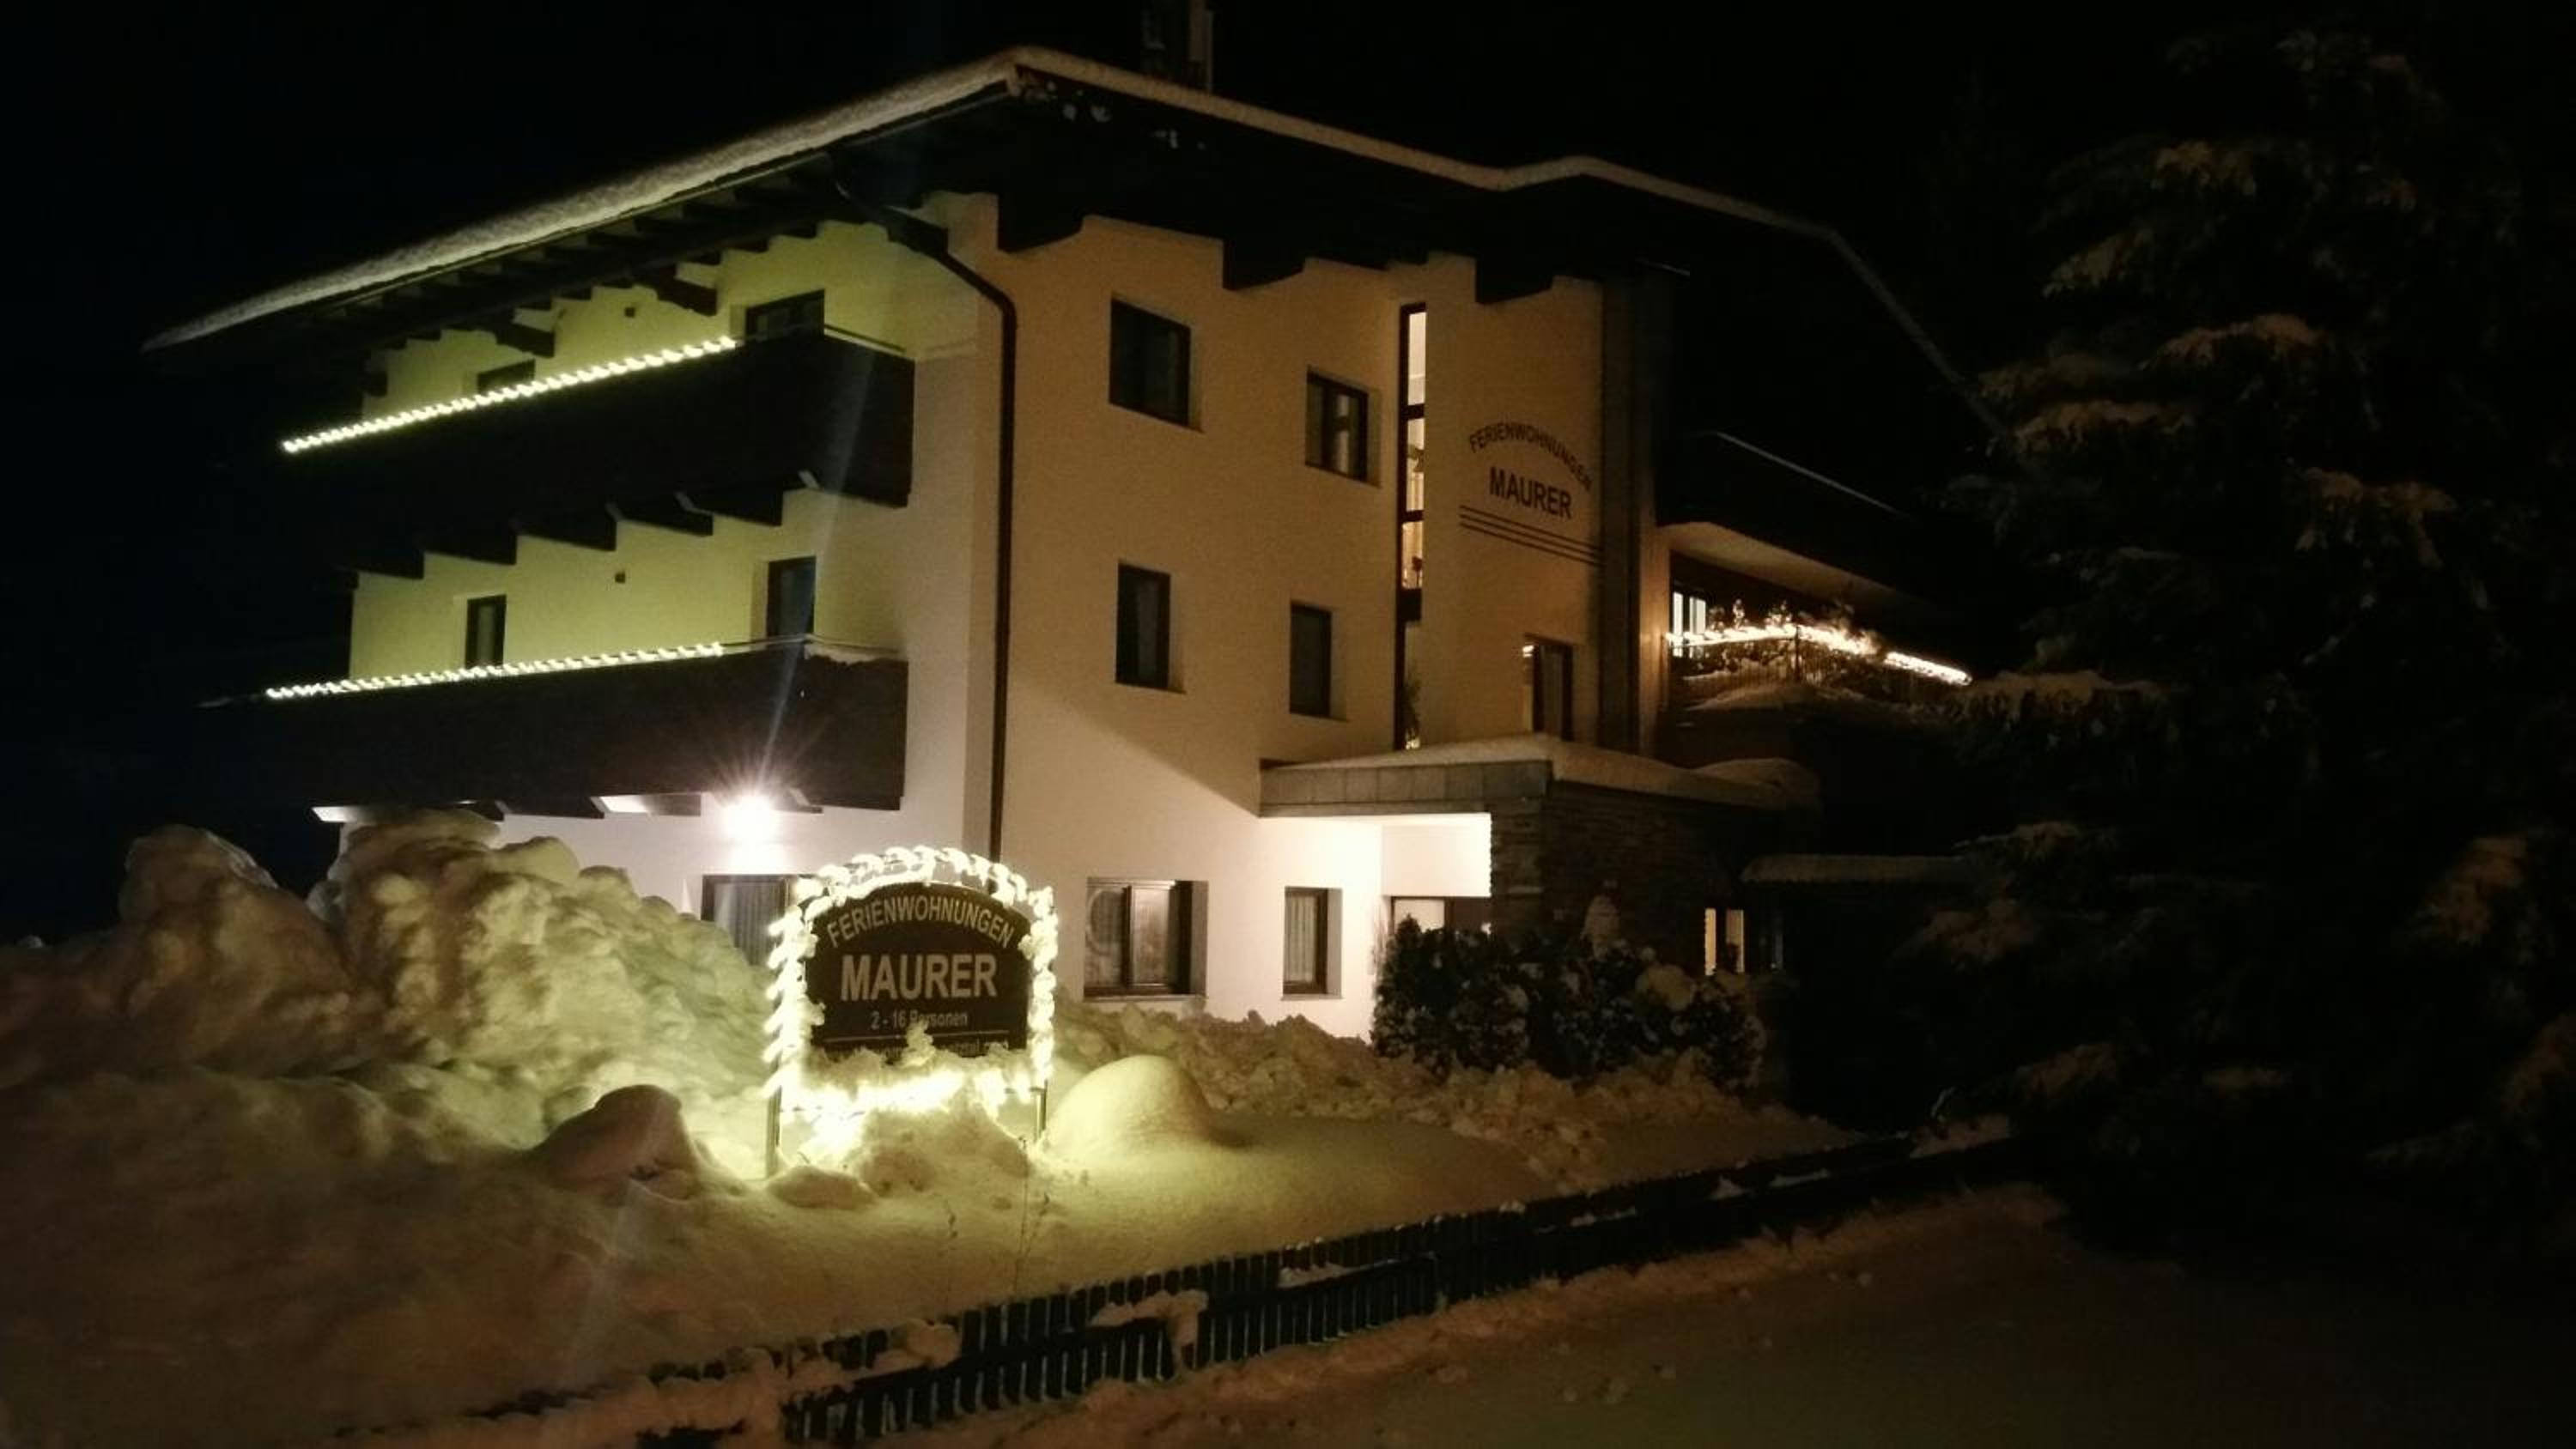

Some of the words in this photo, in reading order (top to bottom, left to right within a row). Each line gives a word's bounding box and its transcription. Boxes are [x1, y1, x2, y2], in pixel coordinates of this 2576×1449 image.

[1469, 421, 1593, 492] FERIENWOHNUNGEN
[1489, 466, 1572, 519] MAURER
[827, 894, 1015, 949] FERIENWOHNUNGEN
[840, 954, 998, 1002] MAURER
[871, 1010, 880, 1030] 2
[893, 1009, 907, 1028] 16
